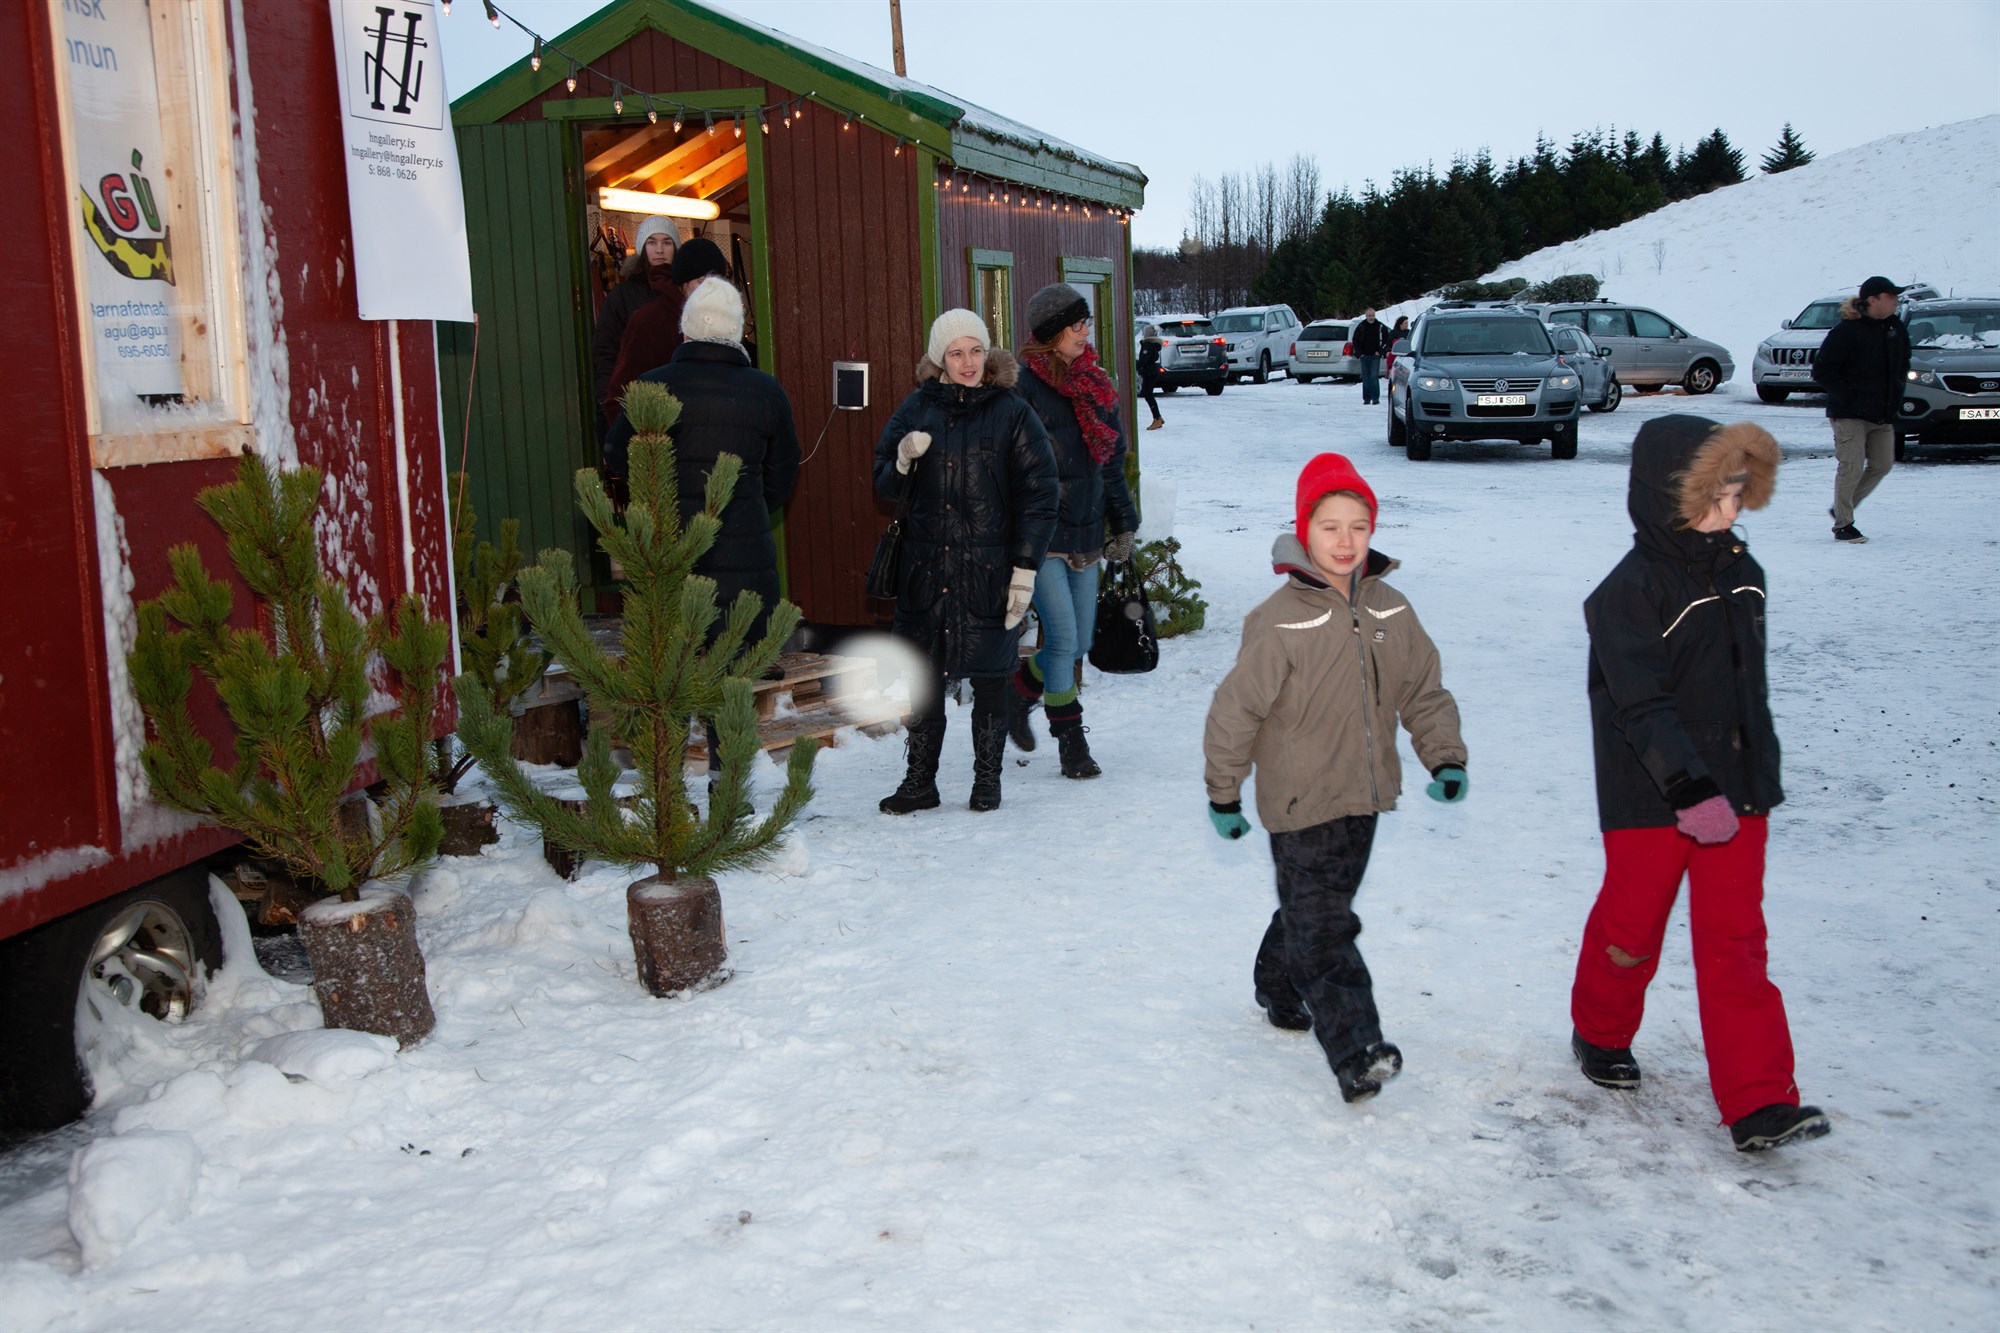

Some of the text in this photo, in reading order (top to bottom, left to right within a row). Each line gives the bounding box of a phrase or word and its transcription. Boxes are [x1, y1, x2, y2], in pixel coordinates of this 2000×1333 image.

[368, 131, 416, 150] hngallery.is
[351, 144, 444, 169] hngallery@hngallery.is
[368, 164, 376, 175] S:
[377, 165, 391, 177] 868
[396, 168, 417, 181] 0626
[1485, 396, 1497, 404] SJ
[1967, 410, 1982, 418] SA
